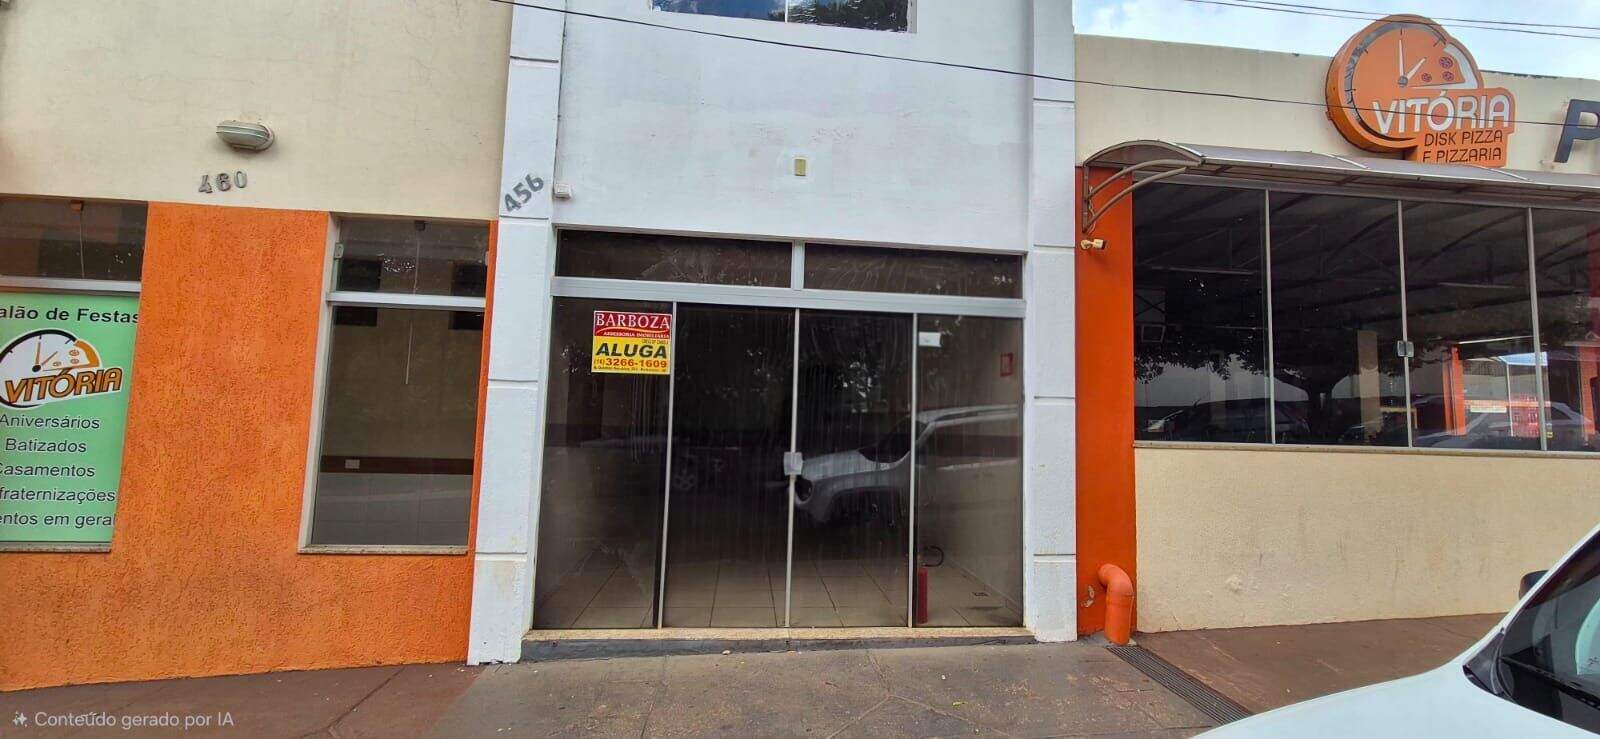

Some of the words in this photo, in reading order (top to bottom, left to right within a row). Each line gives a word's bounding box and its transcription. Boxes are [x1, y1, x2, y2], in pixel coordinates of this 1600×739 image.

[1372, 90, 1510, 134] VITÓRIA
[1424, 131, 1457, 147] DISK
[1461, 130, 1503, 146] PIZZA
[1437, 147, 1503, 163] PIZZARIA
[198, 170, 248, 194] 460
[504, 174, 545, 212] 456
[46, 307, 69, 321] de
[596, 313, 670, 329] BARBOZA
[595, 342, 667, 359] ALUGA
[605, 358, 668, 368] 3266-1609
[5, 367, 123, 404] VITÓRIA
[0, 414, 100, 429] Aniversários
[5, 438, 87, 453] Batizados
[44, 515, 70, 526] em
